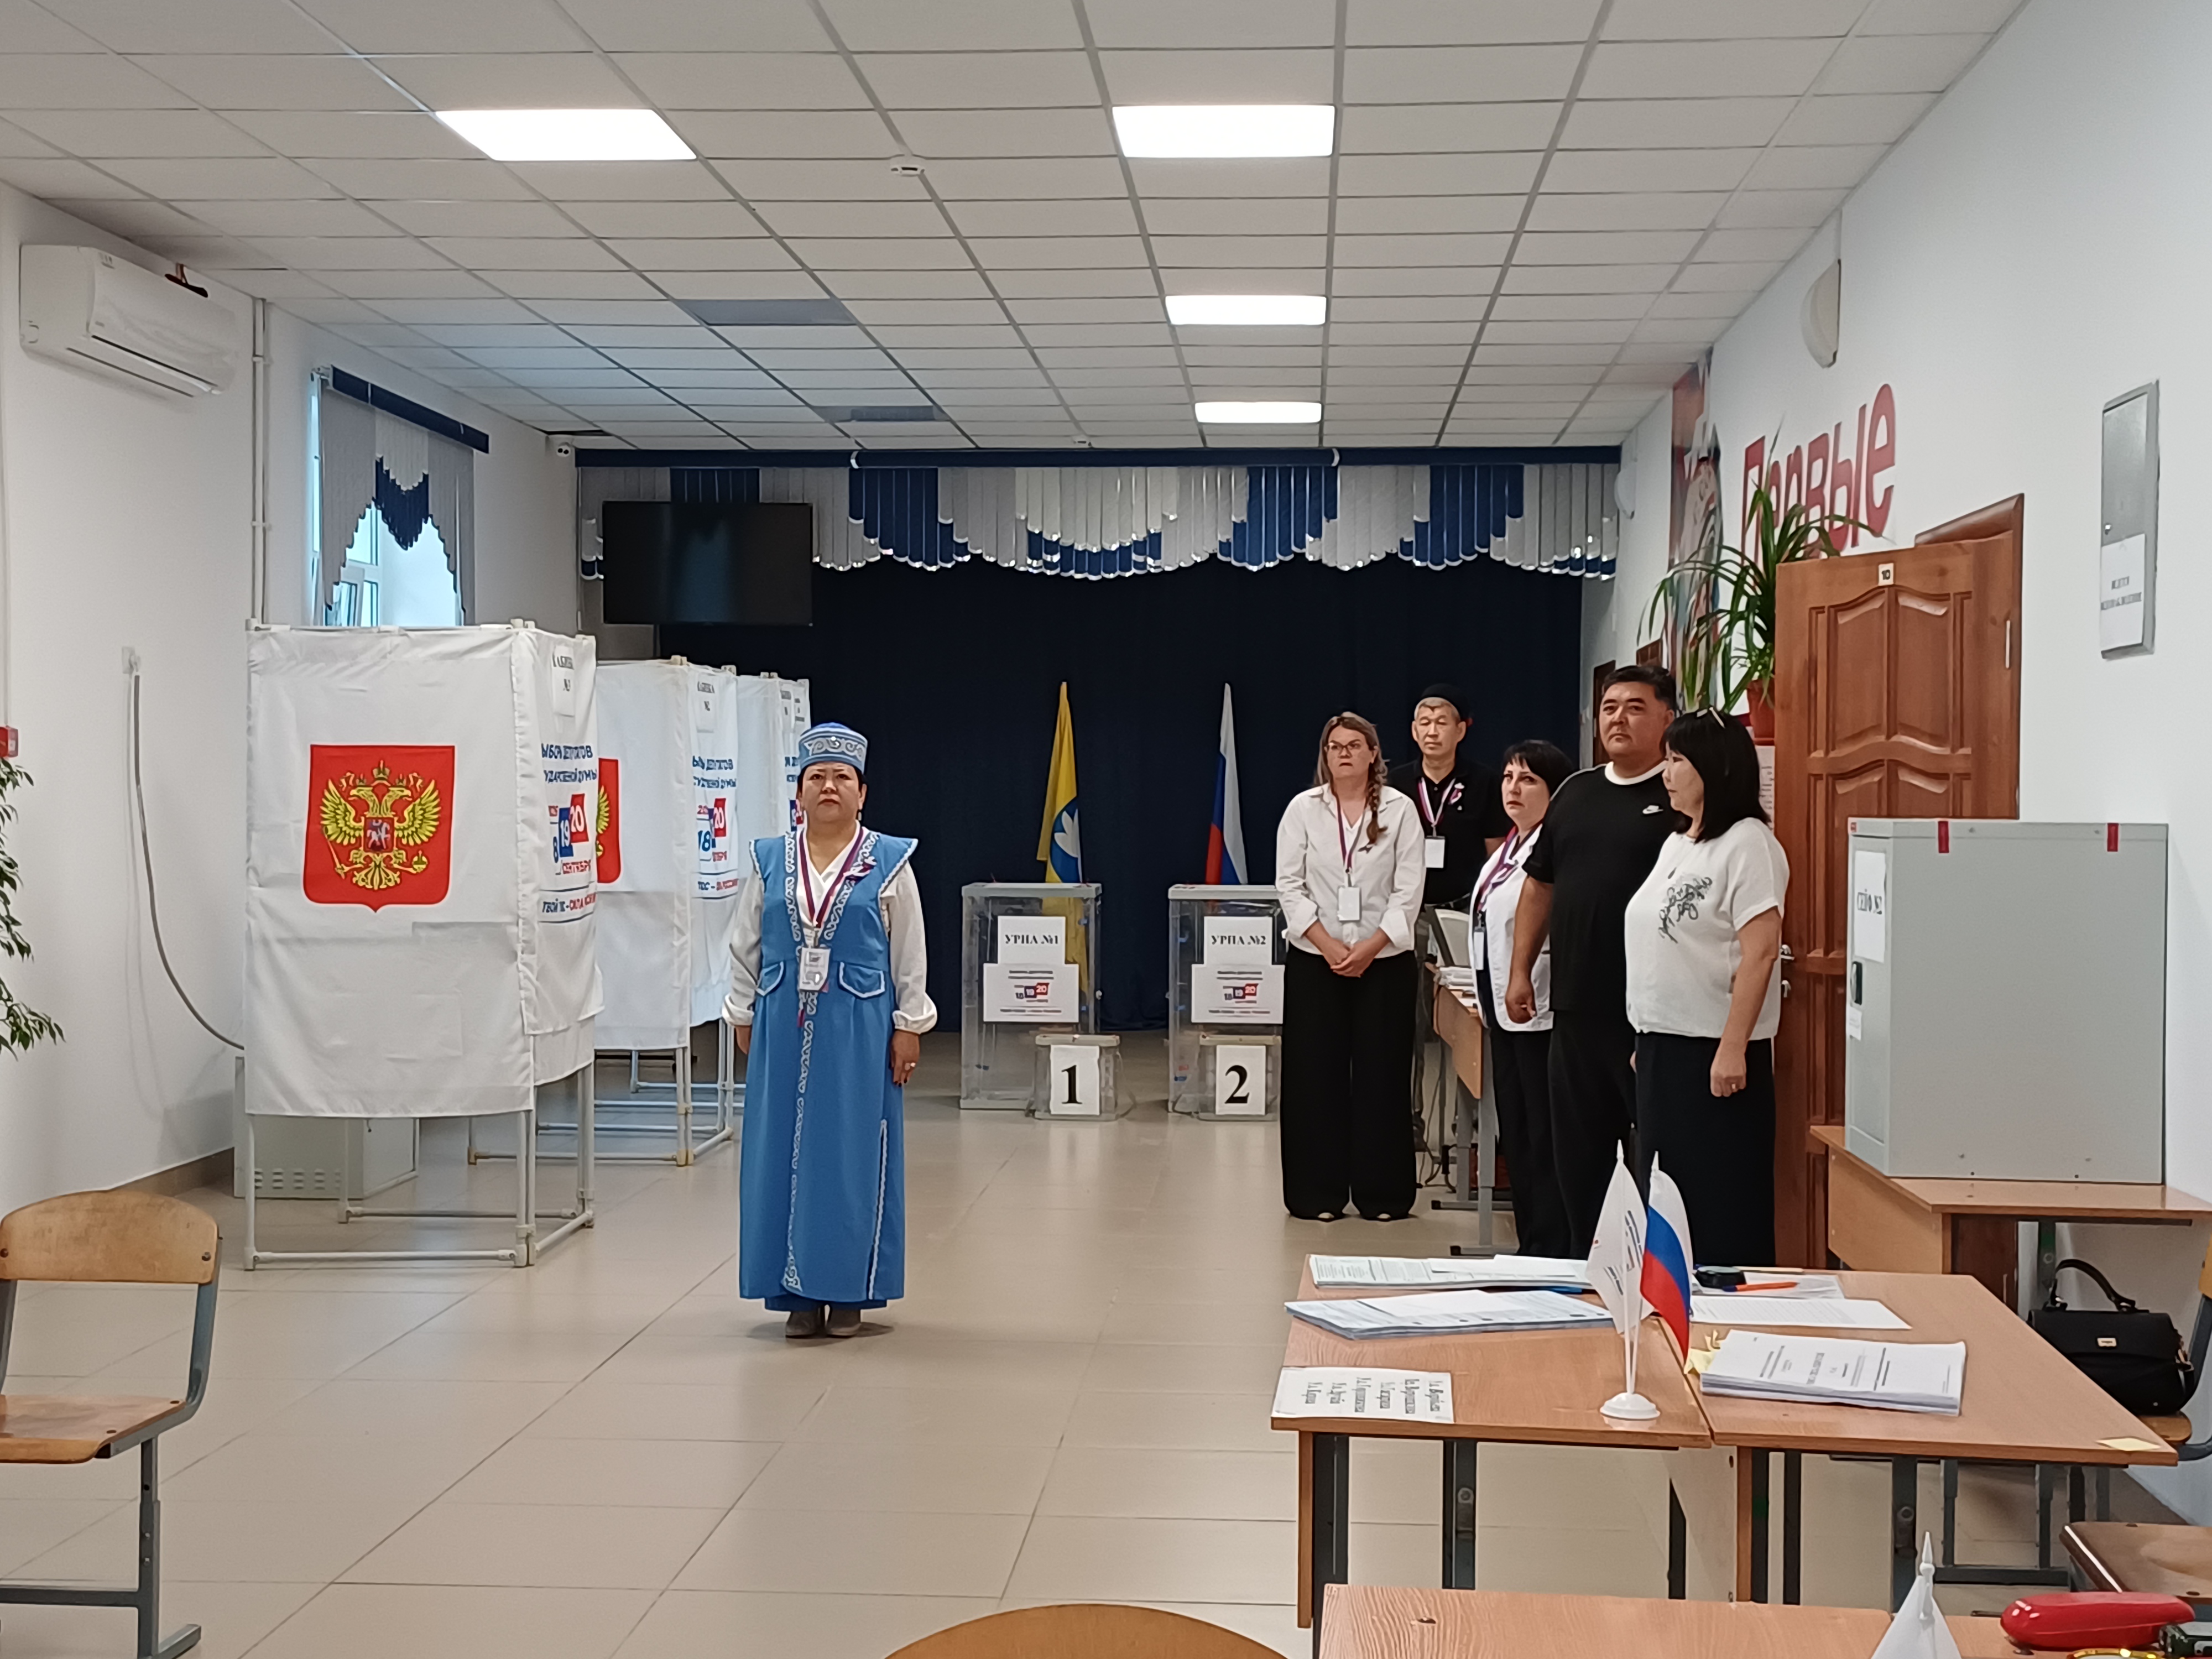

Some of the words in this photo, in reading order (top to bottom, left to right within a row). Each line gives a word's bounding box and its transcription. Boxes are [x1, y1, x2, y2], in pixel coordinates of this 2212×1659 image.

[1881, 569, 1891, 580] 10
[568, 805, 585, 832] 20
[714, 807, 724, 829] 20
[560, 820, 570, 847] 19
[697, 830, 711, 852] 18
[1061, 1065, 1082, 1104] 1
[1224, 1065, 1250, 1104] 2
